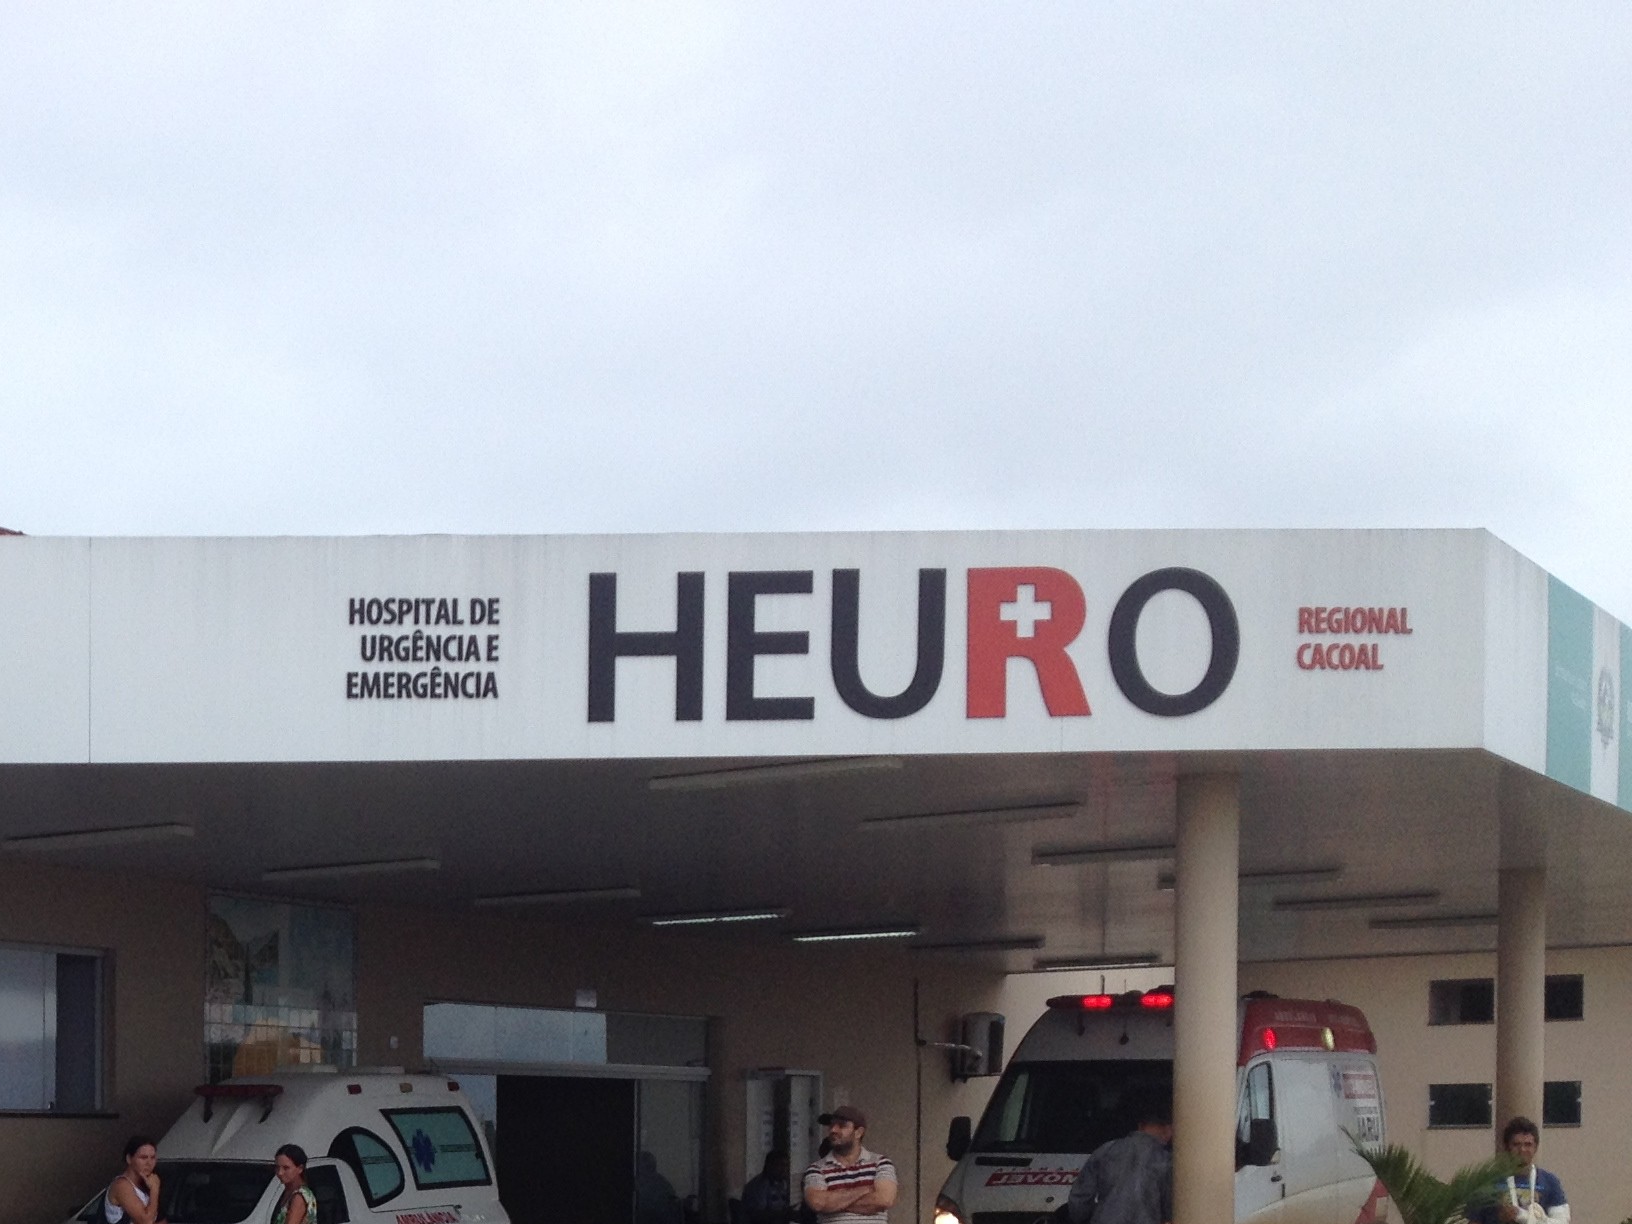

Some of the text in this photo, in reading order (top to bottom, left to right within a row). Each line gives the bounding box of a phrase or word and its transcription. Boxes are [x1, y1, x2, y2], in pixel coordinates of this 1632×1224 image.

[349, 597, 500, 626] HOSPITAL DE
[1298, 606, 1413, 637] REGIONAL
[360, 630, 499, 663] URGÊNCIA E
[587, 566, 1240, 723] HEURO
[1297, 642, 1384, 672] CACOAL
[346, 667, 499, 700] EMERGÊNCIA
